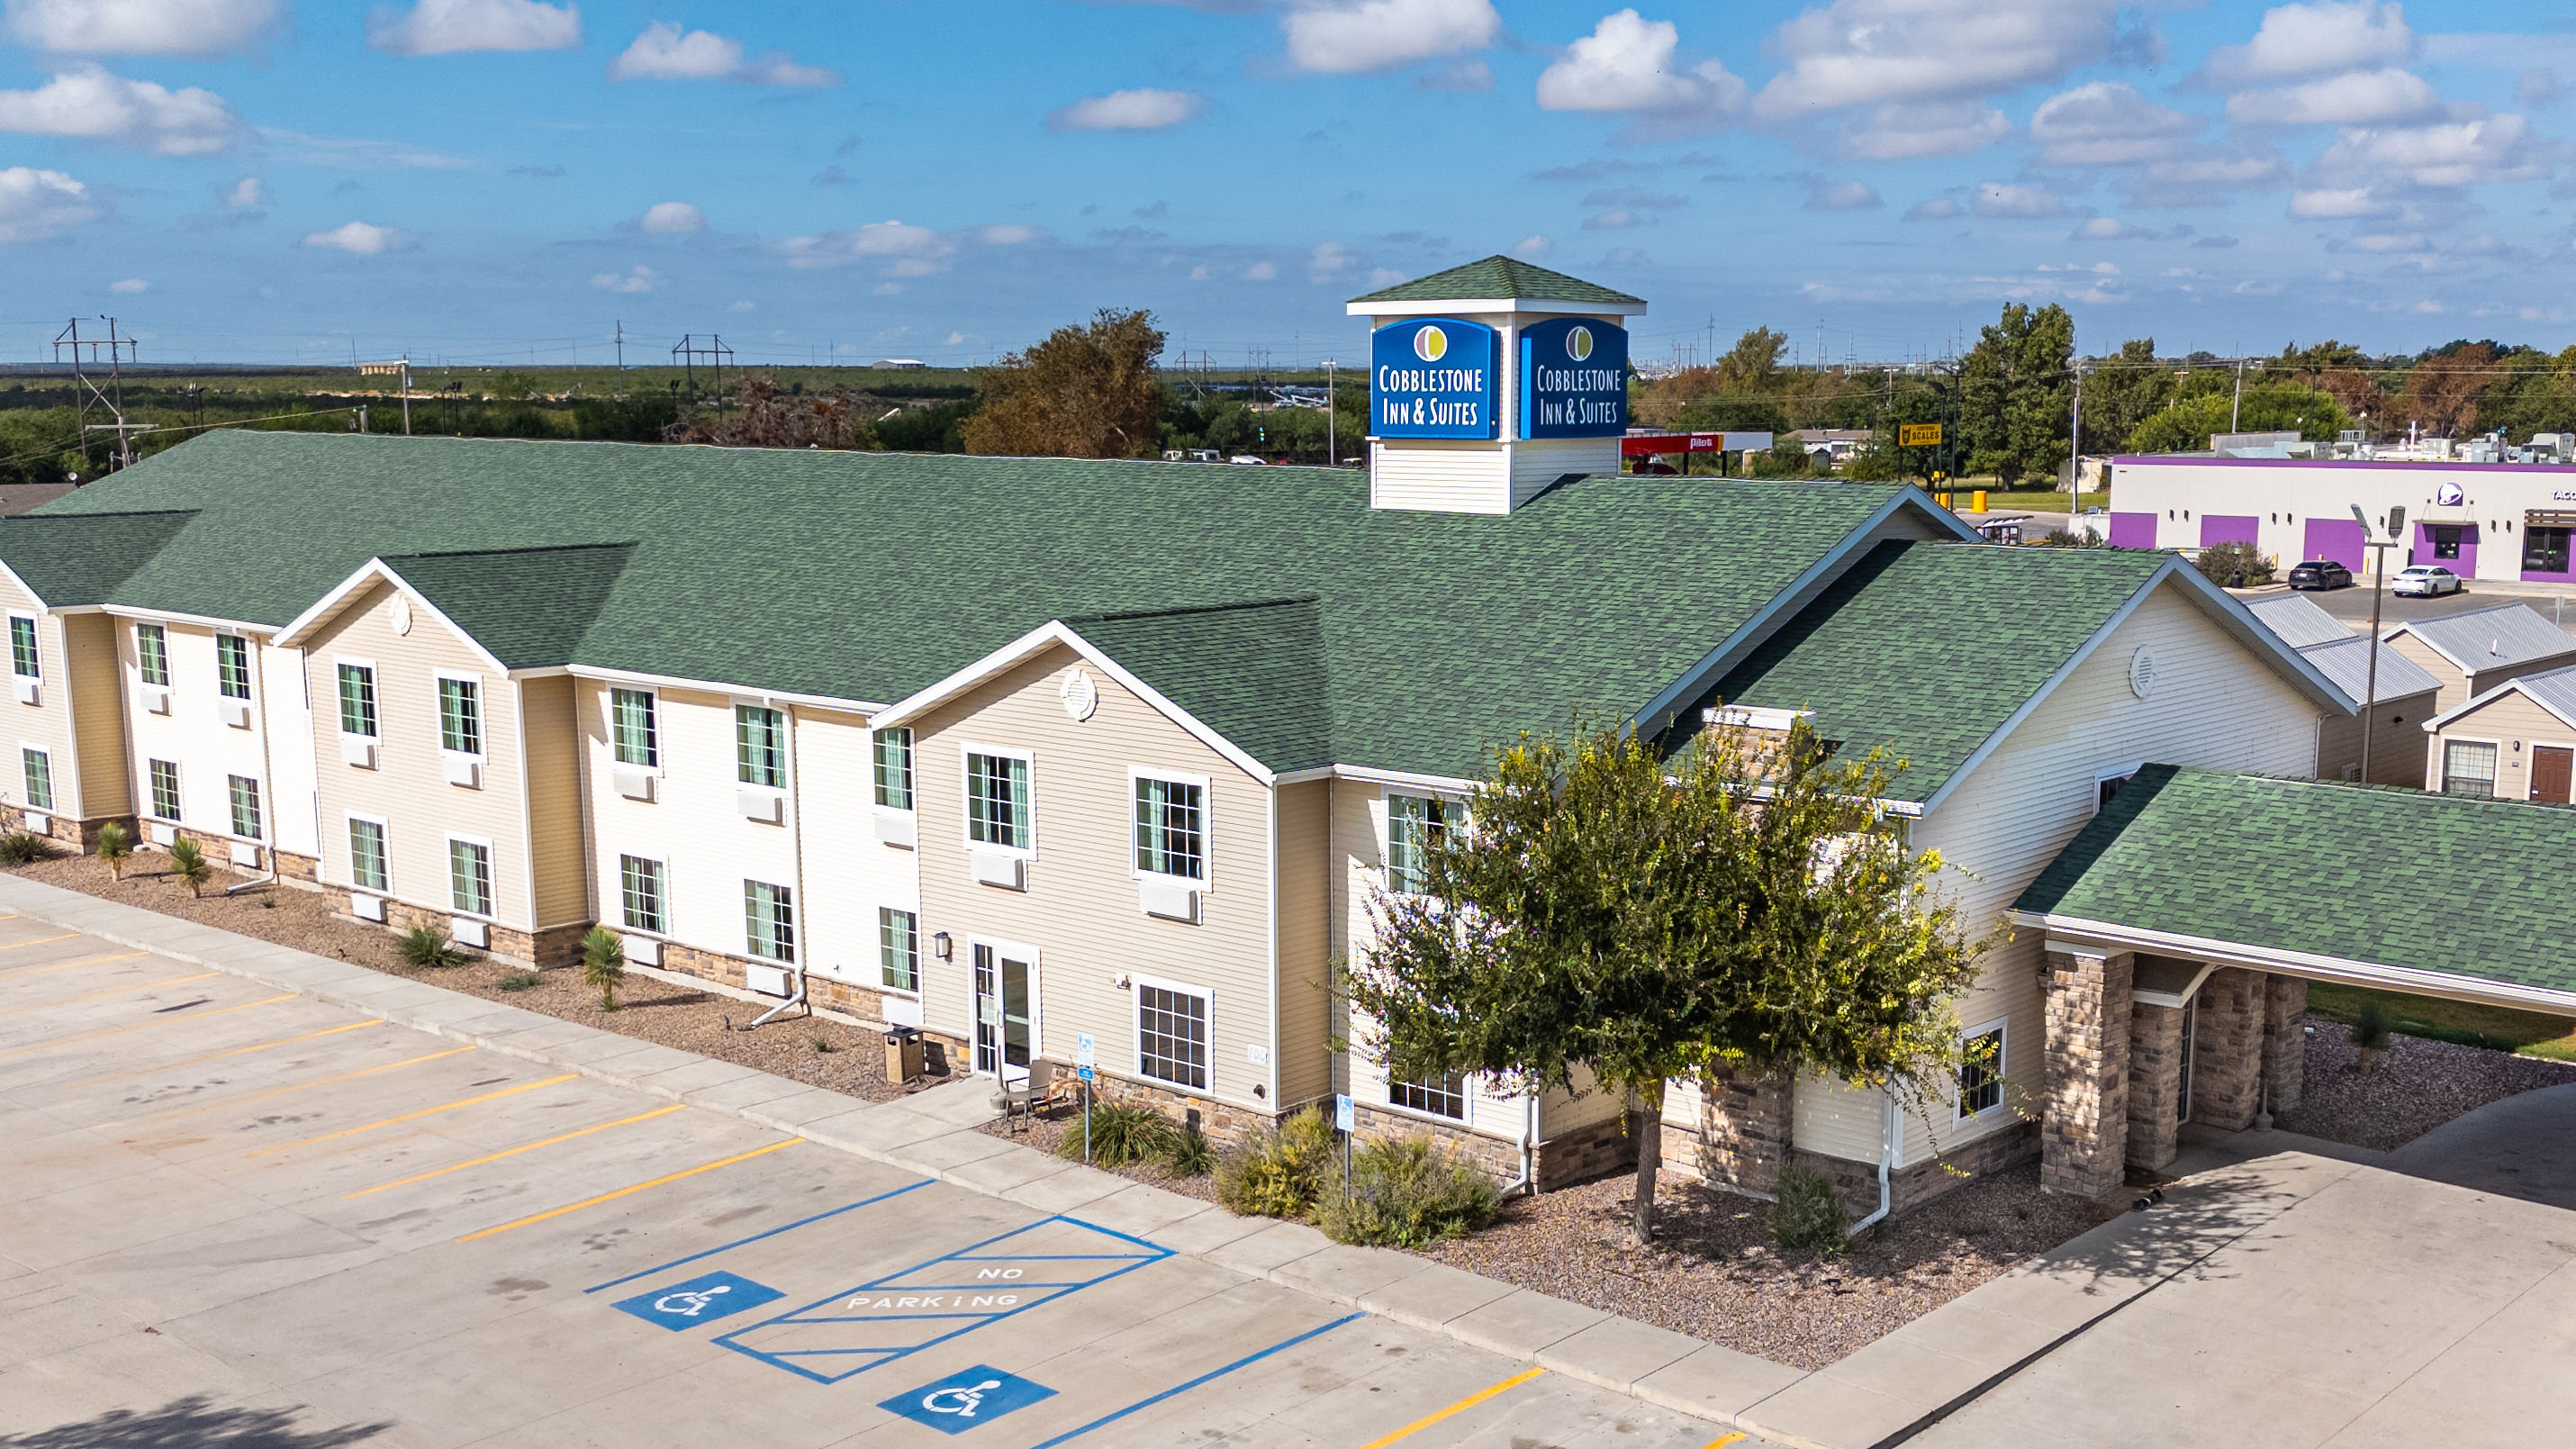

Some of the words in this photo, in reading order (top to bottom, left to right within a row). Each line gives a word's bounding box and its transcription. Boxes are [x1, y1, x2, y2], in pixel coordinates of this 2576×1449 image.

[1379, 365, 1482, 392] COBBLESTONE
[1538, 365, 1621, 392] COBBLESTONE
[1383, 398, 1409, 425] INN
[1413, 398, 1425, 425] &
[1430, 398, 1478, 425] SUITES
[1541, 398, 1562, 425] INN
[1566, 398, 1576, 425] &
[1579, 397, 1617, 424] SUITES
[1912, 431, 1939, 439] SCALES
[977, 1268, 1023, 1279] NO
[847, 1295, 1018, 1309] PARKING
